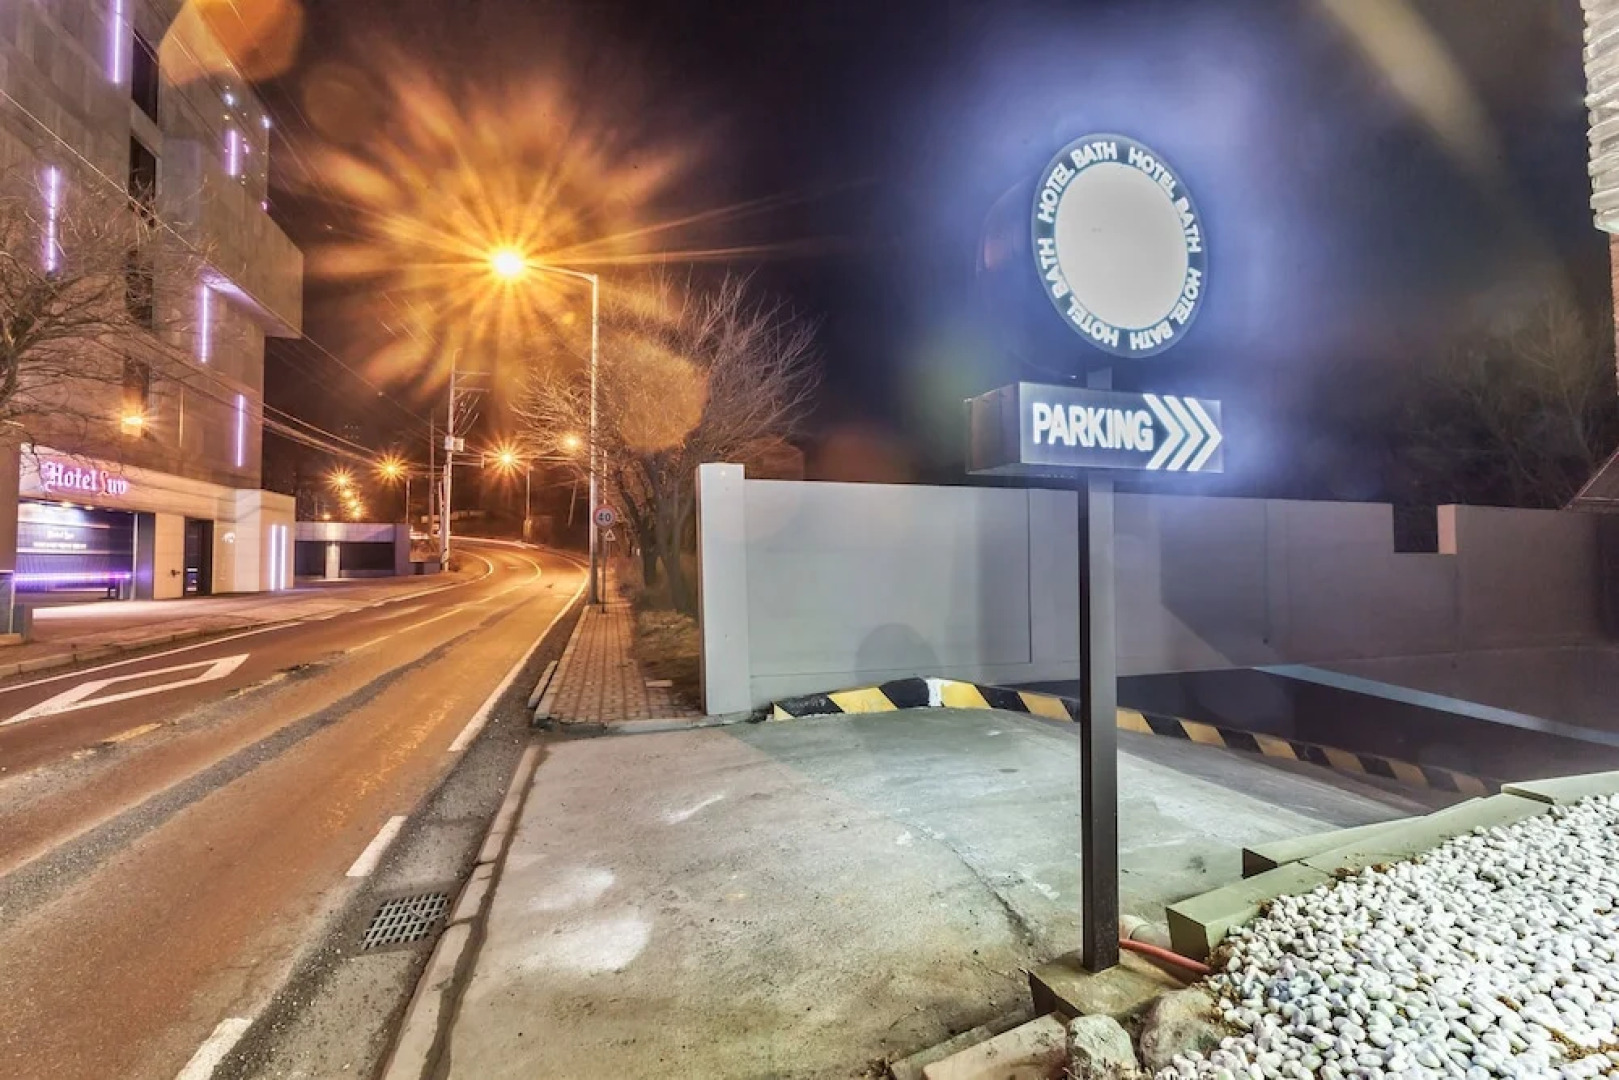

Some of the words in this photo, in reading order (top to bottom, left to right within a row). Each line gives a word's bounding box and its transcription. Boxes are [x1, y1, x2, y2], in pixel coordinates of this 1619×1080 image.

[1037, 163, 1075, 223] HOTEL
[1070, 141, 1118, 169] BATH
[1127, 147, 1177, 198] HOTEL
[1174, 196, 1202, 253] BATH
[1037, 237, 1070, 299] BATH
[1066, 296, 1120, 347] HOTEL
[1169, 267, 1202, 325] HOTEL
[1129, 319, 1174, 350] BATH
[1032, 402, 1154, 451] PARKING
[40, 461, 98, 493] Hotel
[598, 512, 611, 522] 40
